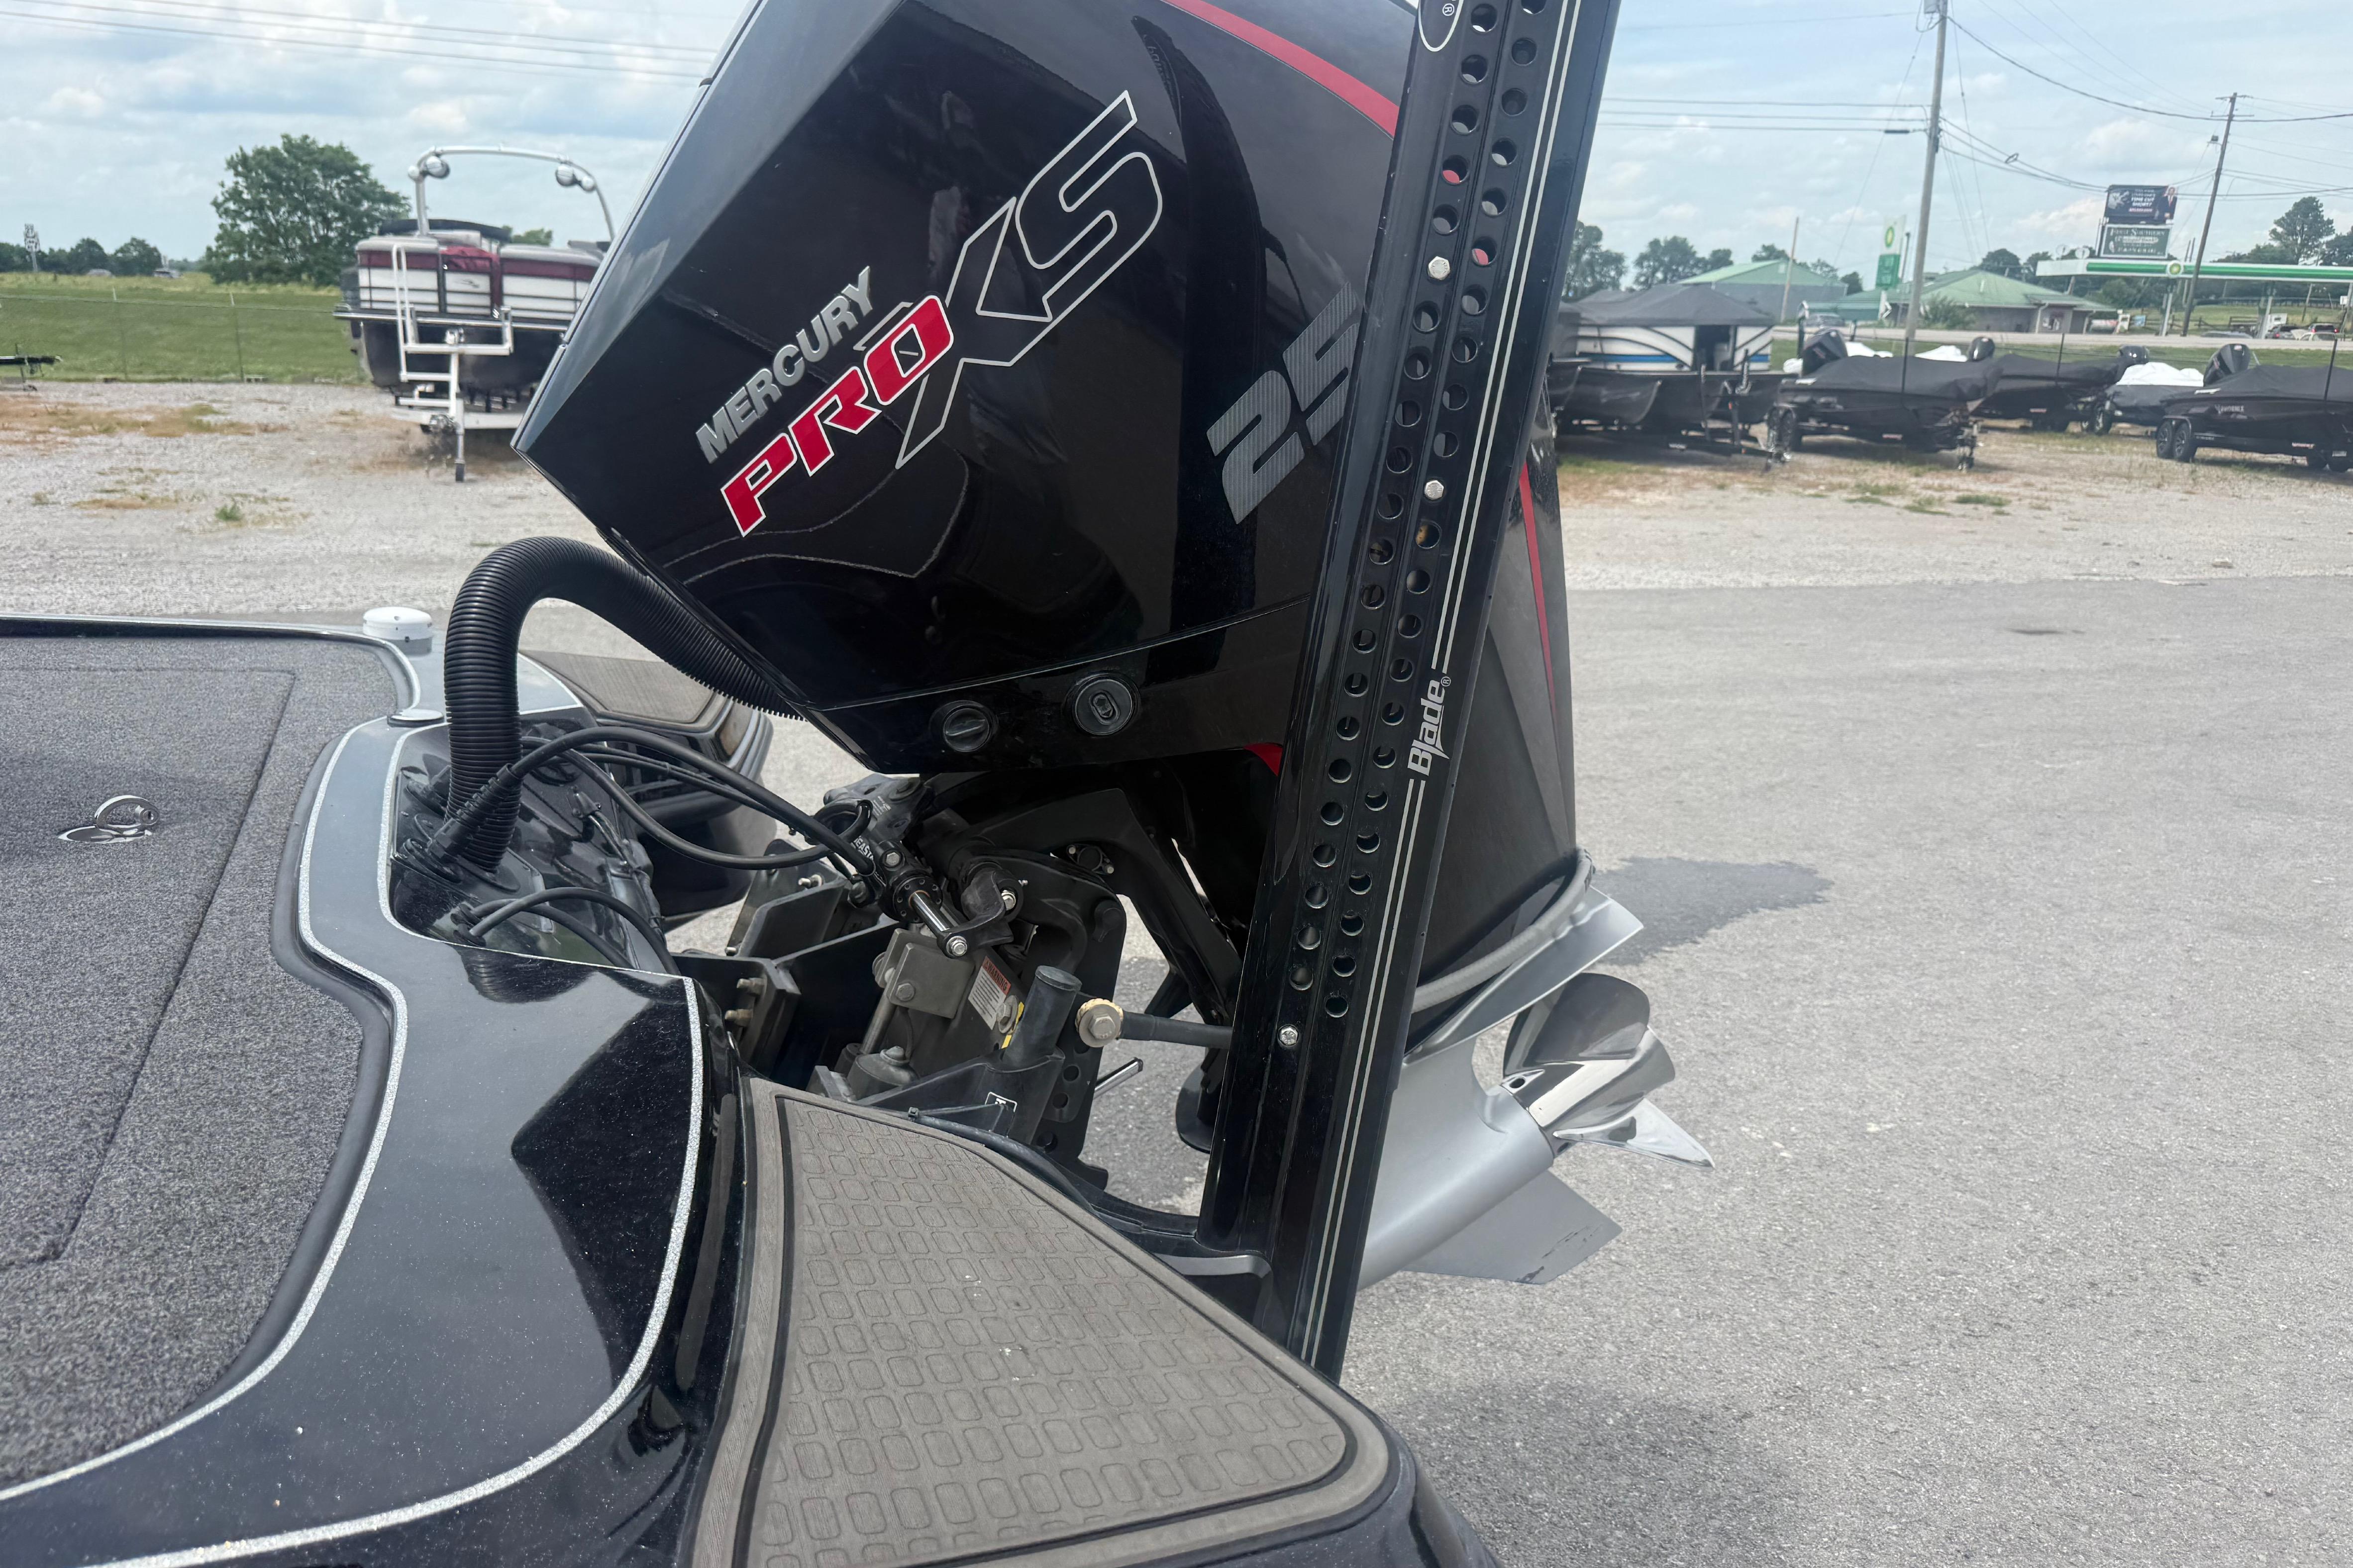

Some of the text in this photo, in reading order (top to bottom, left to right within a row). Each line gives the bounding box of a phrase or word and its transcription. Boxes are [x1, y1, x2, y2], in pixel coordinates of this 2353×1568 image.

[696, 266, 873, 464] MERCURY
[721, 90, 1162, 537] PRO XS
[987, 963, 1008, 991] WARNING
